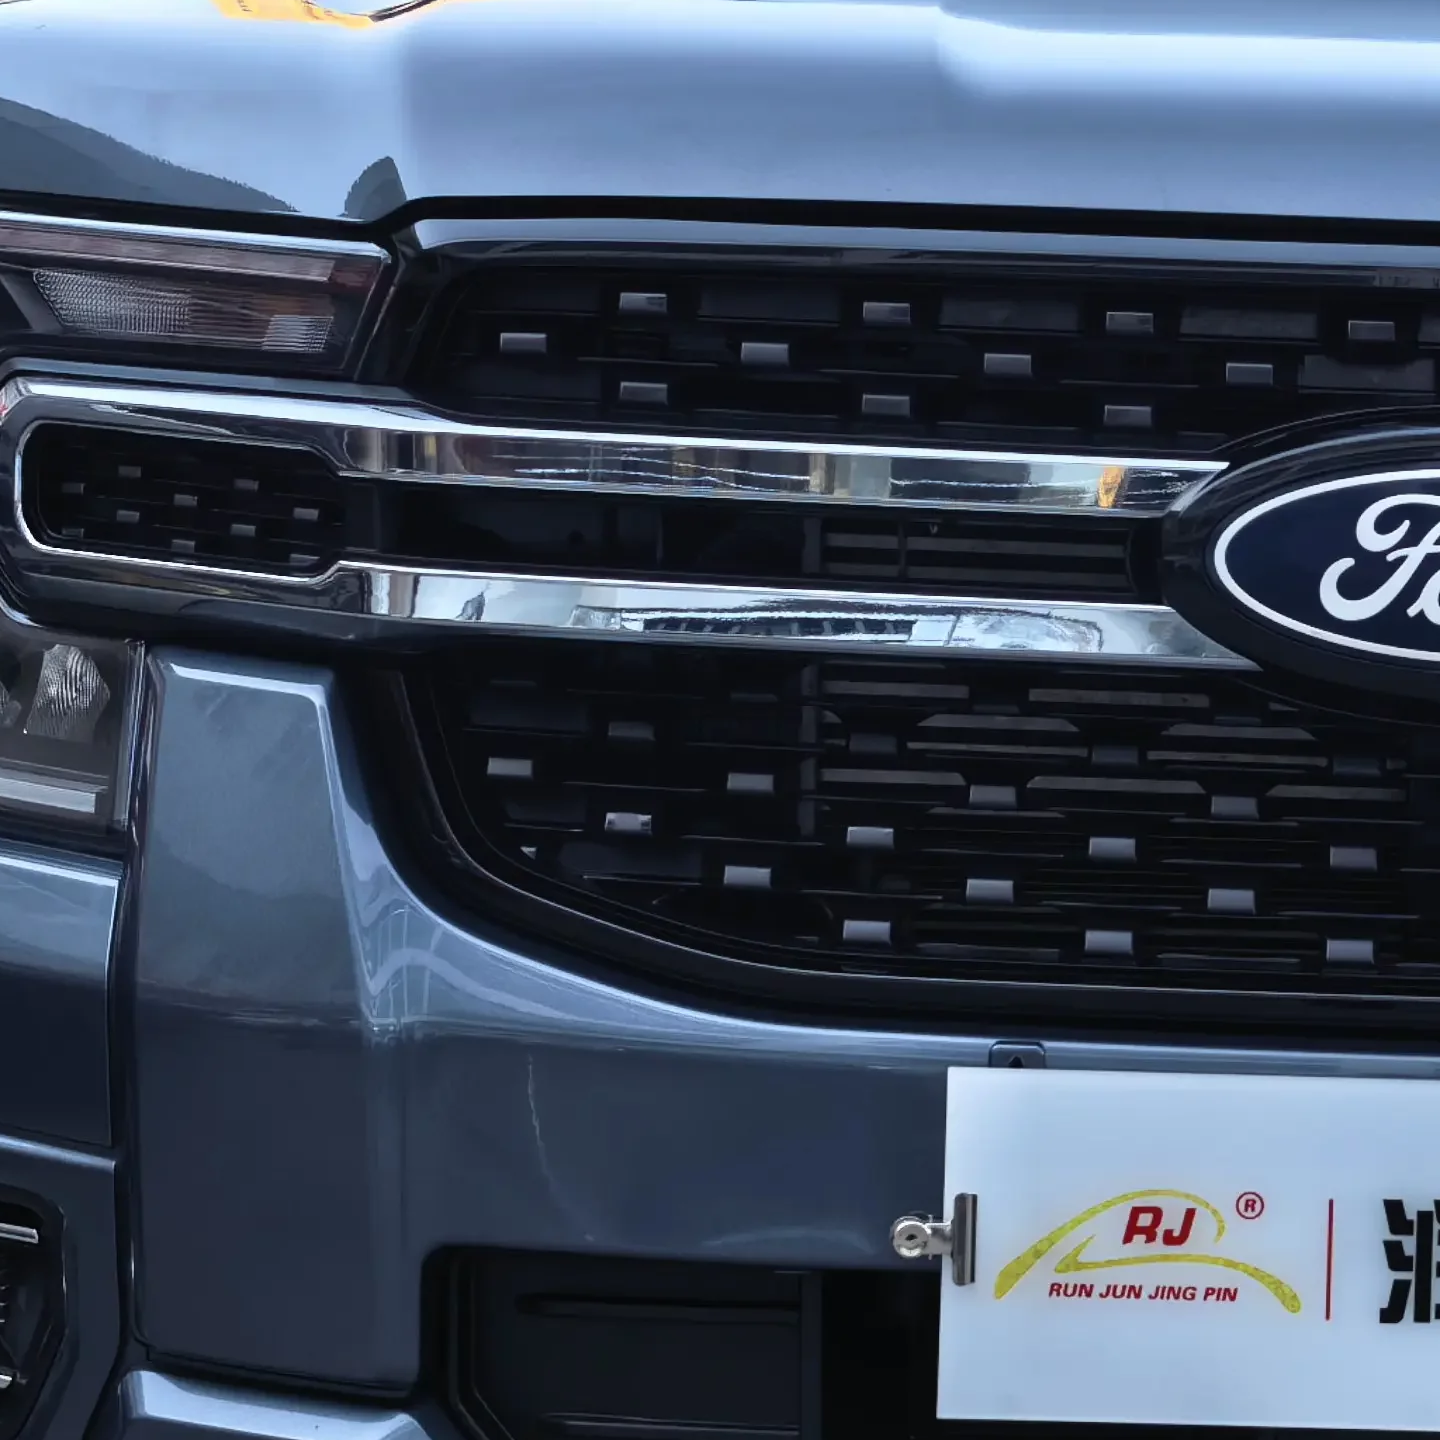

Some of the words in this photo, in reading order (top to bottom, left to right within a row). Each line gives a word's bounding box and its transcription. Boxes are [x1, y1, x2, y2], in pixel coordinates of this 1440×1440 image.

[1121, 1204, 1197, 1247] RJ
[1048, 1282, 1093, 1298] RUN
[1099, 1284, 1143, 1300] JUN
[1148, 1285, 1197, 1301] JING
[1203, 1286, 1239, 1302] PIN
